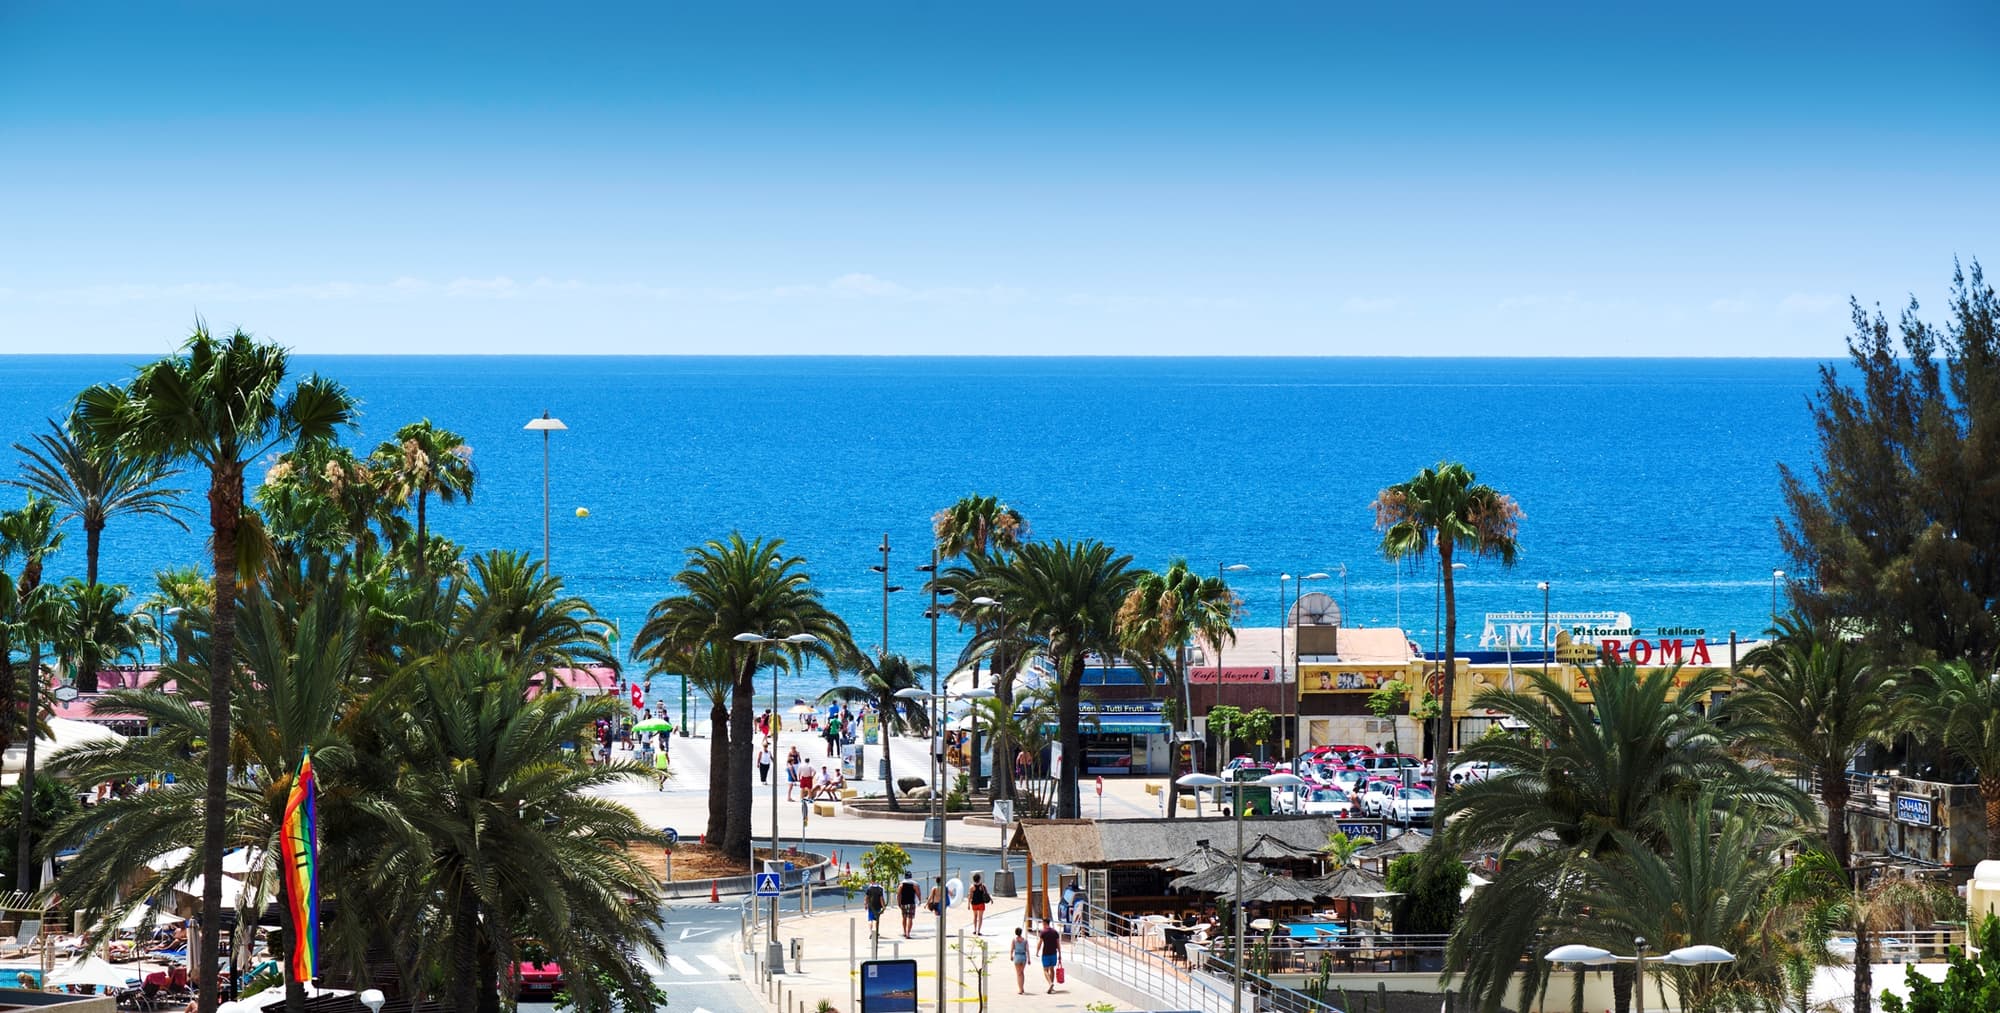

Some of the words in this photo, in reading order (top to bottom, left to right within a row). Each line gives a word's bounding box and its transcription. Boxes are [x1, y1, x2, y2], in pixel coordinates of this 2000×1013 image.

[1573, 627, 1640, 636] Ristorante
[1657, 627, 1706, 636] Italiano
[1601, 638, 1712, 666] ROMA
[1900, 799, 1928, 815] SAHARA
[1342, 826, 1379, 834] HARA
